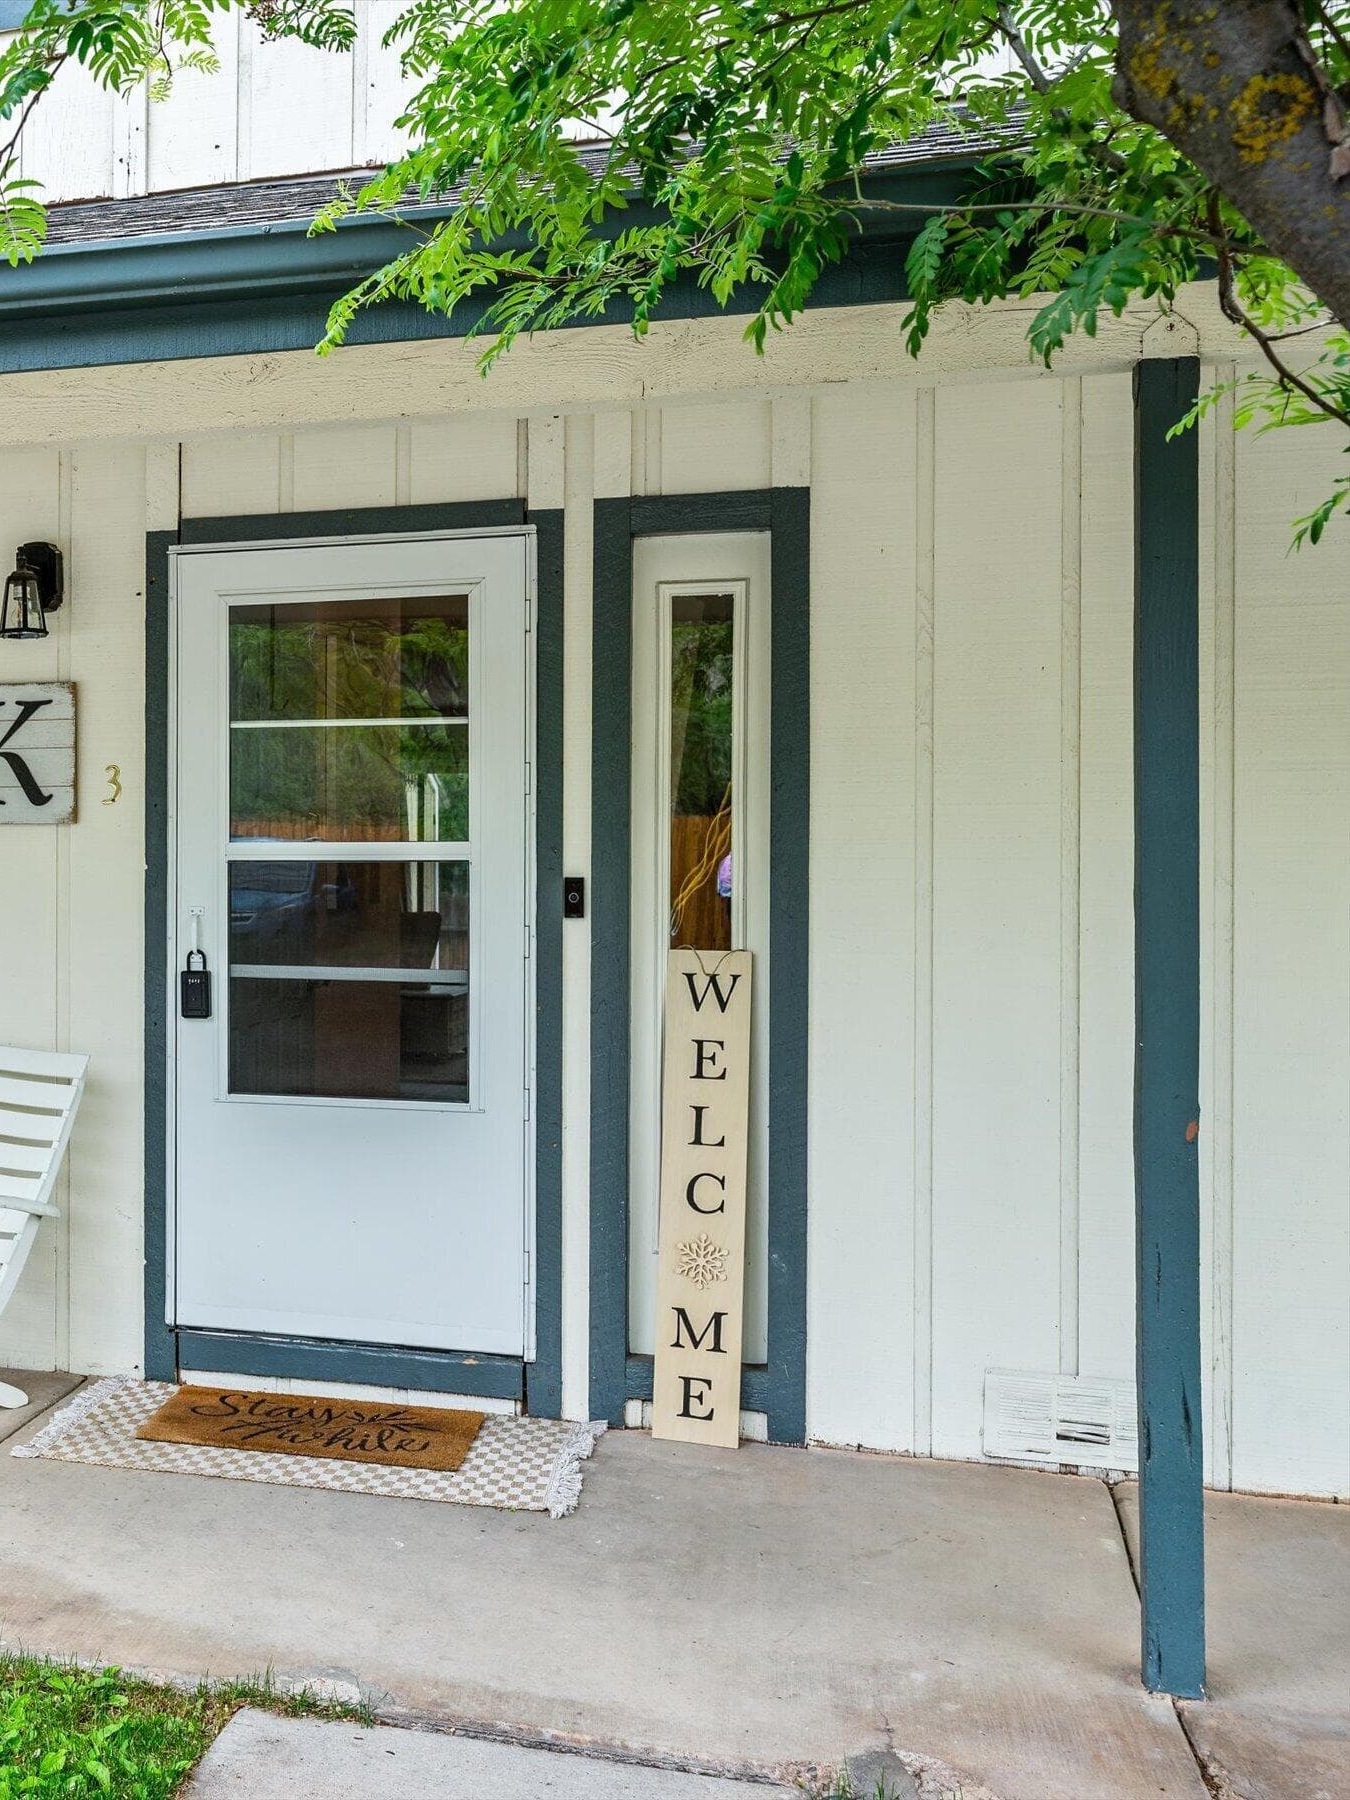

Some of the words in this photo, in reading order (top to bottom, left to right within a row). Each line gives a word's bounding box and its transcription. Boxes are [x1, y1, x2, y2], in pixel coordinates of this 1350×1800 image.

[101, 764, 123, 806] 3
[670, 972, 742, 1422] WELCME
[190, 1394, 347, 1428] Stay
